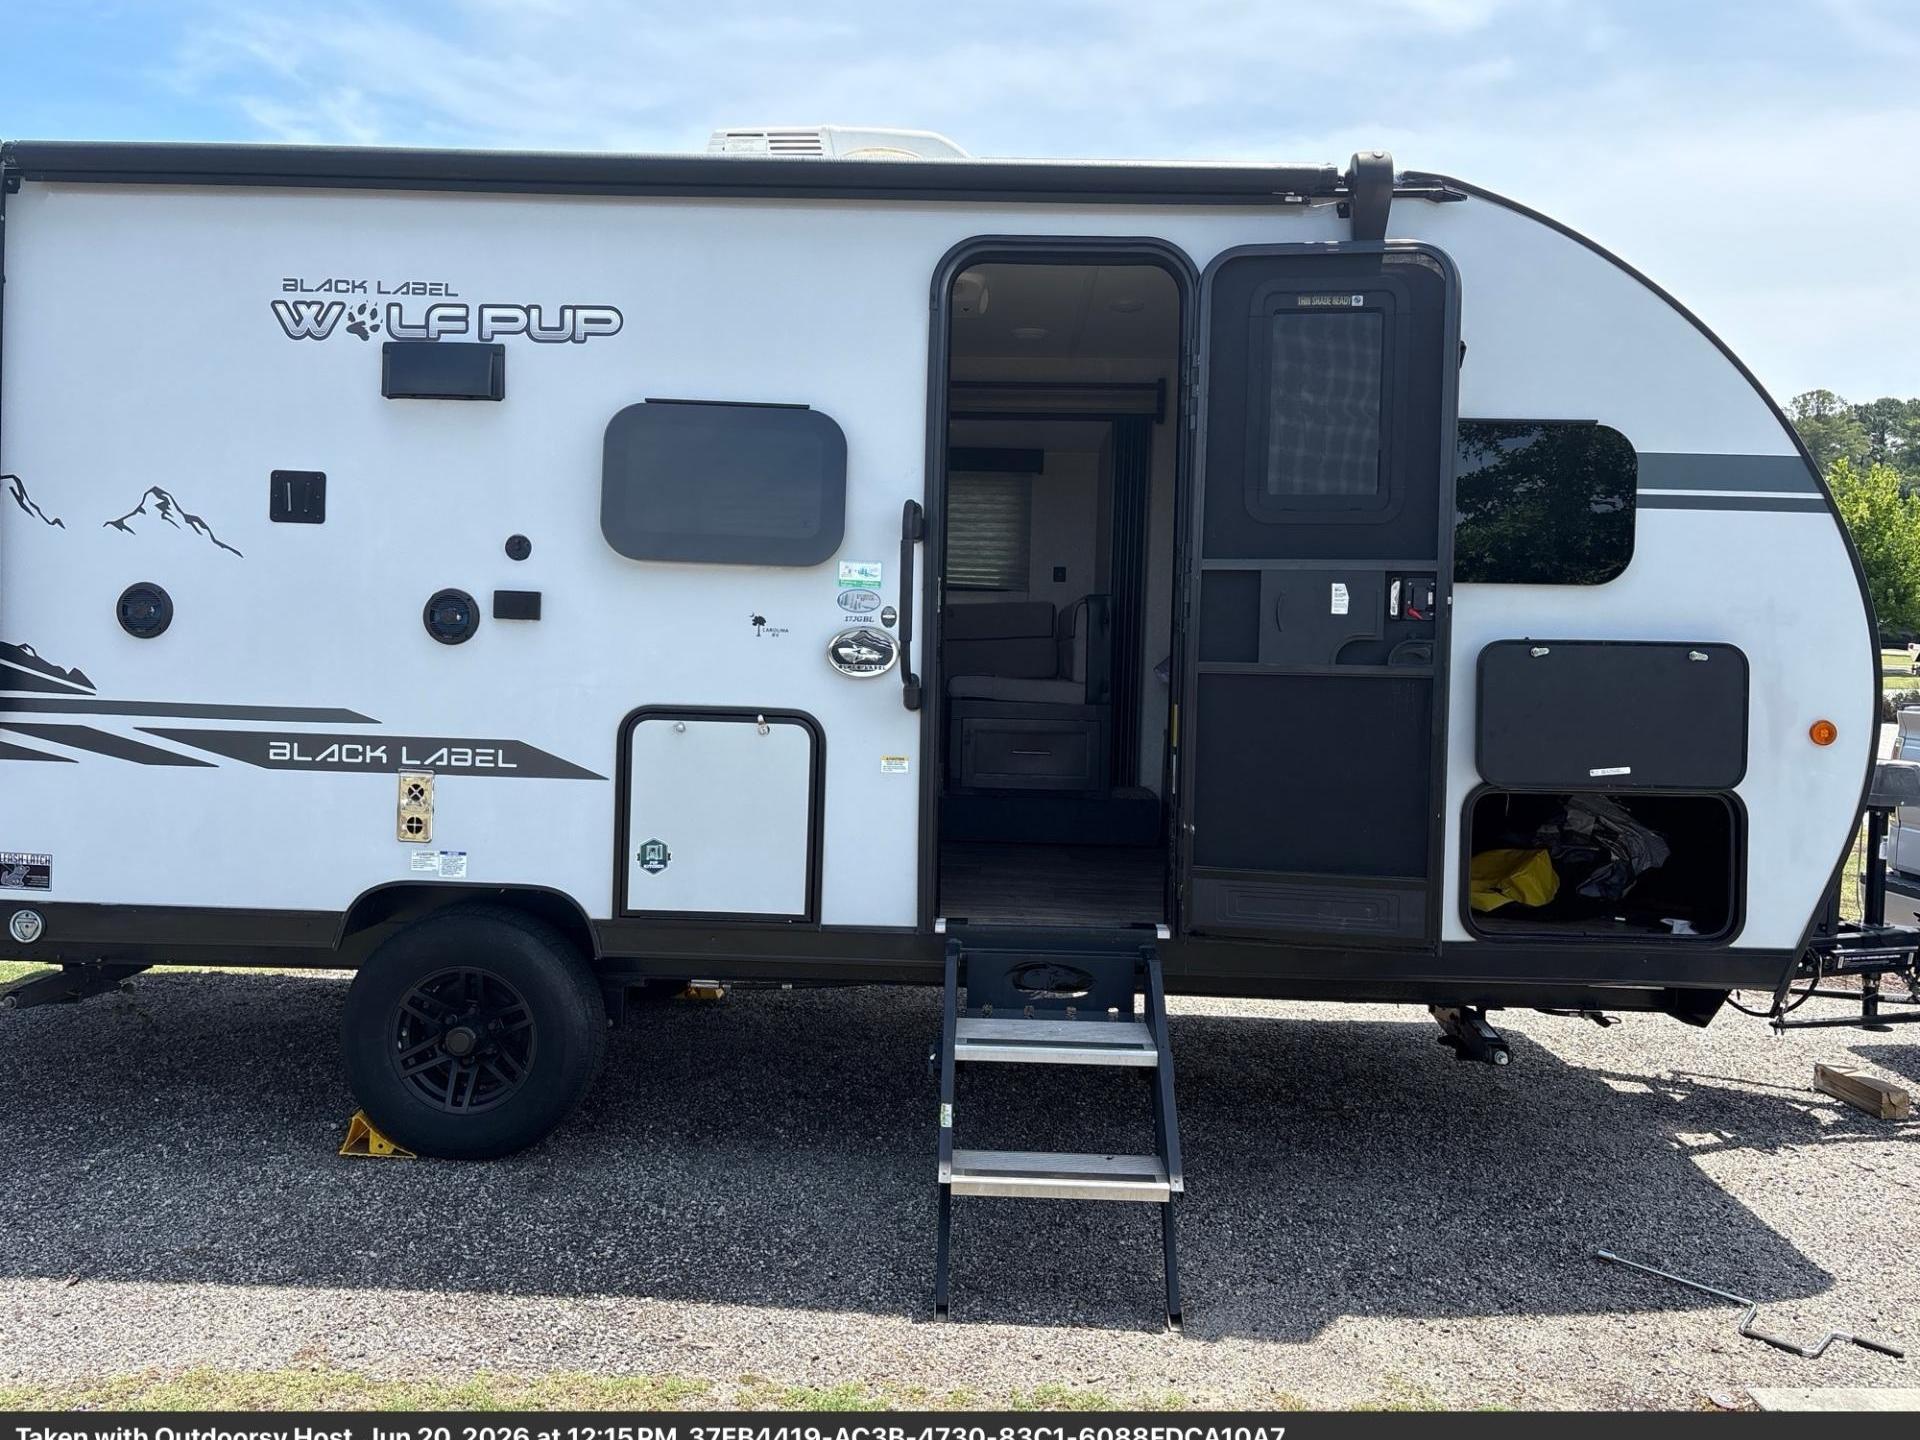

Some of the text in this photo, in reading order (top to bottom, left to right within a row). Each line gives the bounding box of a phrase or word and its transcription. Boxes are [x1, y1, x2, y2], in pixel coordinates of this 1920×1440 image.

[282, 278, 459, 297] BLACK LABEL
[478, 303, 624, 344] PUP
[269, 741, 518, 768] BLACK LABEL
